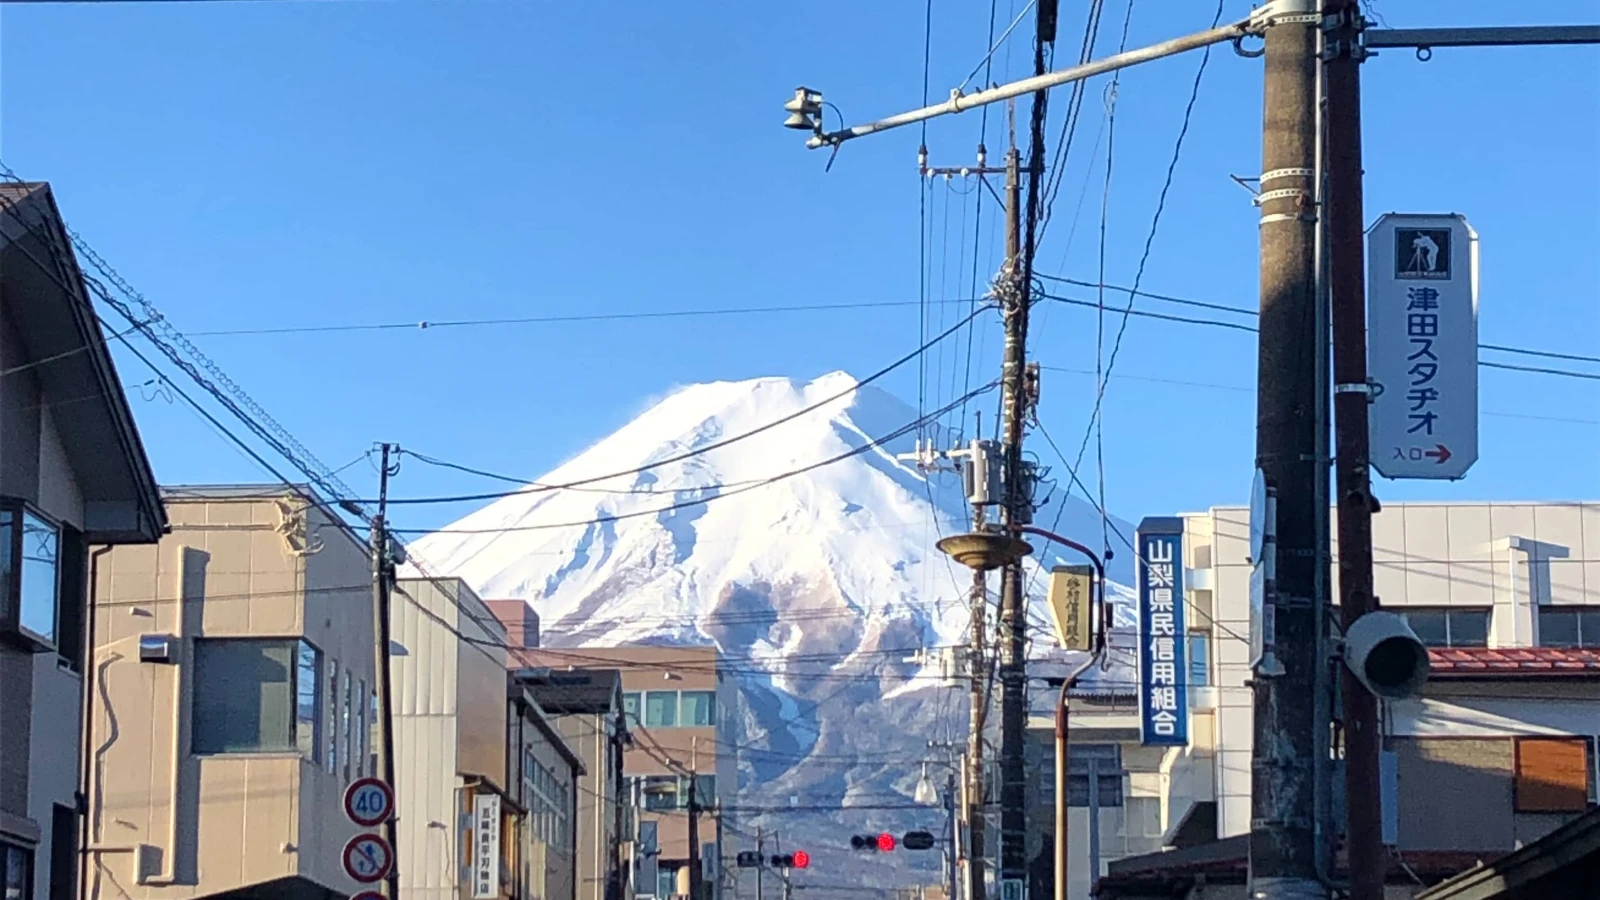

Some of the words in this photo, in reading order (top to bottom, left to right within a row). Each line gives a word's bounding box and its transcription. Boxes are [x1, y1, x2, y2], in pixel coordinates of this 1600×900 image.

[1406, 287, 1439, 435] 津田スタヂオ
[1393, 447, 1422, 460] 入口
[1148, 540, 1177, 736] 山梨県民信用組合
[356, 791, 383, 813] 40
